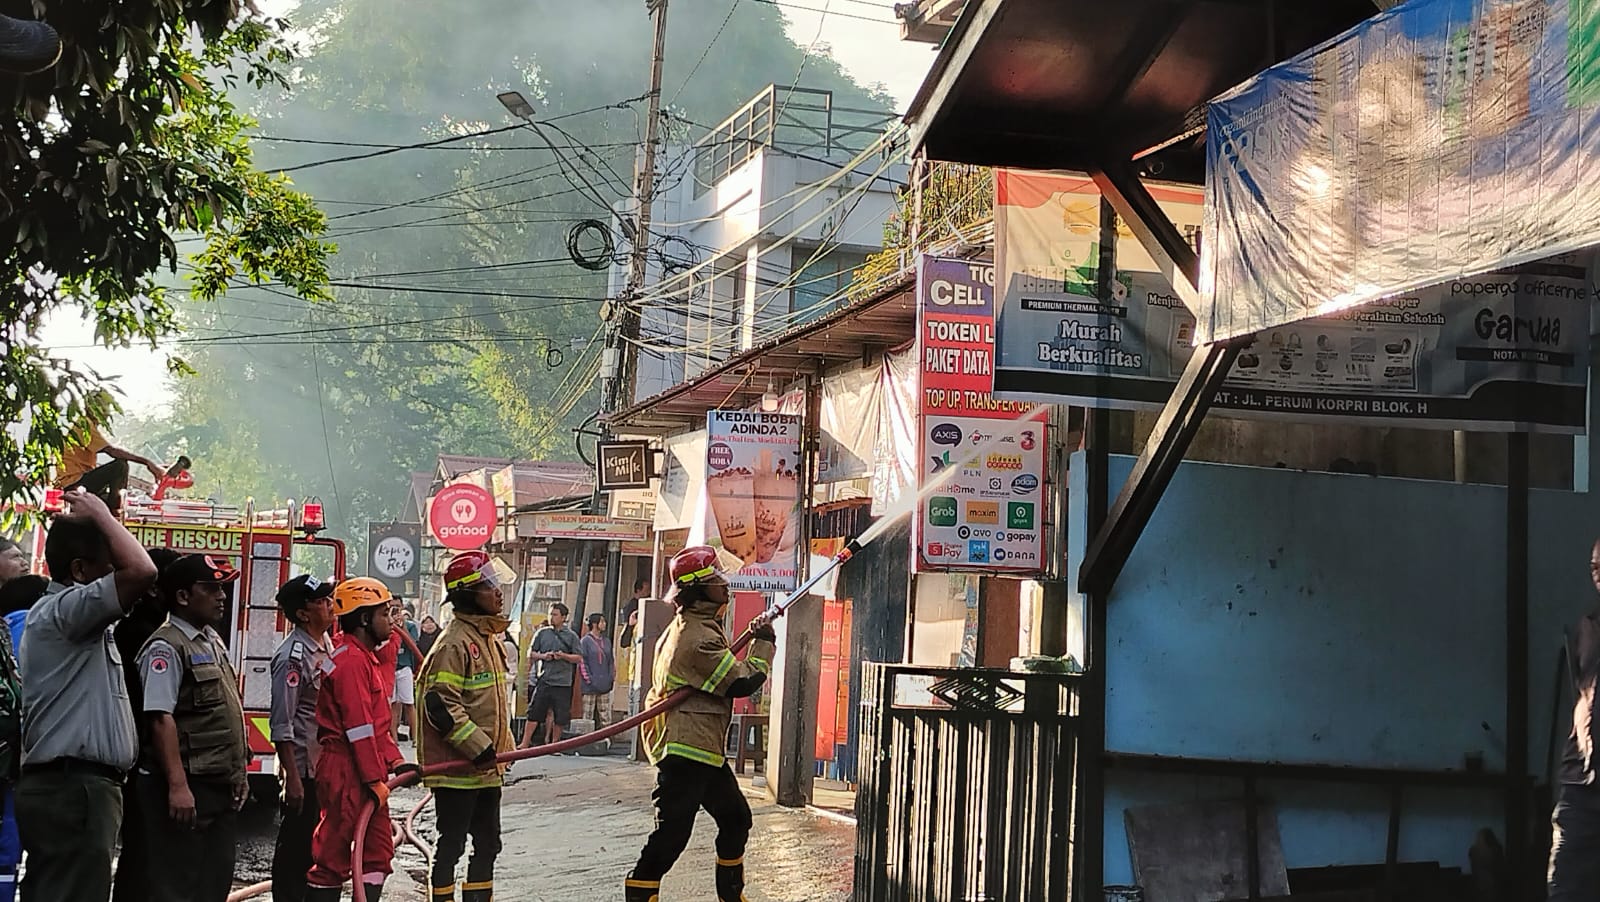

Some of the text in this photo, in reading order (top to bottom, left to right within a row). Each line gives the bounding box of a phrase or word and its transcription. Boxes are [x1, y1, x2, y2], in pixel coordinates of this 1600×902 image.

[930, 280, 985, 306] CELL
[1028, 301, 1062, 312] PREMIUM
[1063, 303, 1098, 313] THERMAL
[1354, 310, 1402, 323] Peralatan
[1403, 312, 1445, 325] Sekolah
[927, 321, 980, 343] TOKEN
[1060, 320, 1121, 342] Murah
[1474, 307, 1562, 346] Garuda
[1038, 343, 1142, 369] Berkualitas
[1493, 350, 1519, 360] NOTA
[926, 347, 990, 376] PAKET DATA
[926, 389, 946, 407] TOP
[947, 390, 962, 411] UP,
[1241, 393, 1261, 407] JL.
[1265, 395, 1312, 410] PERUM
[1316, 397, 1369, 413] KORPRI
[1372, 400, 1414, 414] BLOK.
[1417, 402, 1428, 414] H
[716, 411, 798, 425] KEDAI BOBA
[935, 431, 959, 440] AXIS
[710, 446, 730, 455] FREE
[605, 452, 629, 469] Kim
[710, 457, 731, 466] BOBA
[963, 469, 982, 478] PLN
[1014, 476, 1037, 487] pdam
[930, 506, 955, 517] Grab
[969, 508, 997, 517] maxim
[439, 523, 488, 538] gofood
[129, 527, 242, 551] FIRE RESCUE
[1006, 532, 1037, 542] gopay
[944, 548, 962, 560] Pay
[1007, 552, 1035, 561] DANA
[738, 567, 769, 577] DRINK
[747, 579, 762, 591] Aja
[763, 580, 786, 590] Dulu
